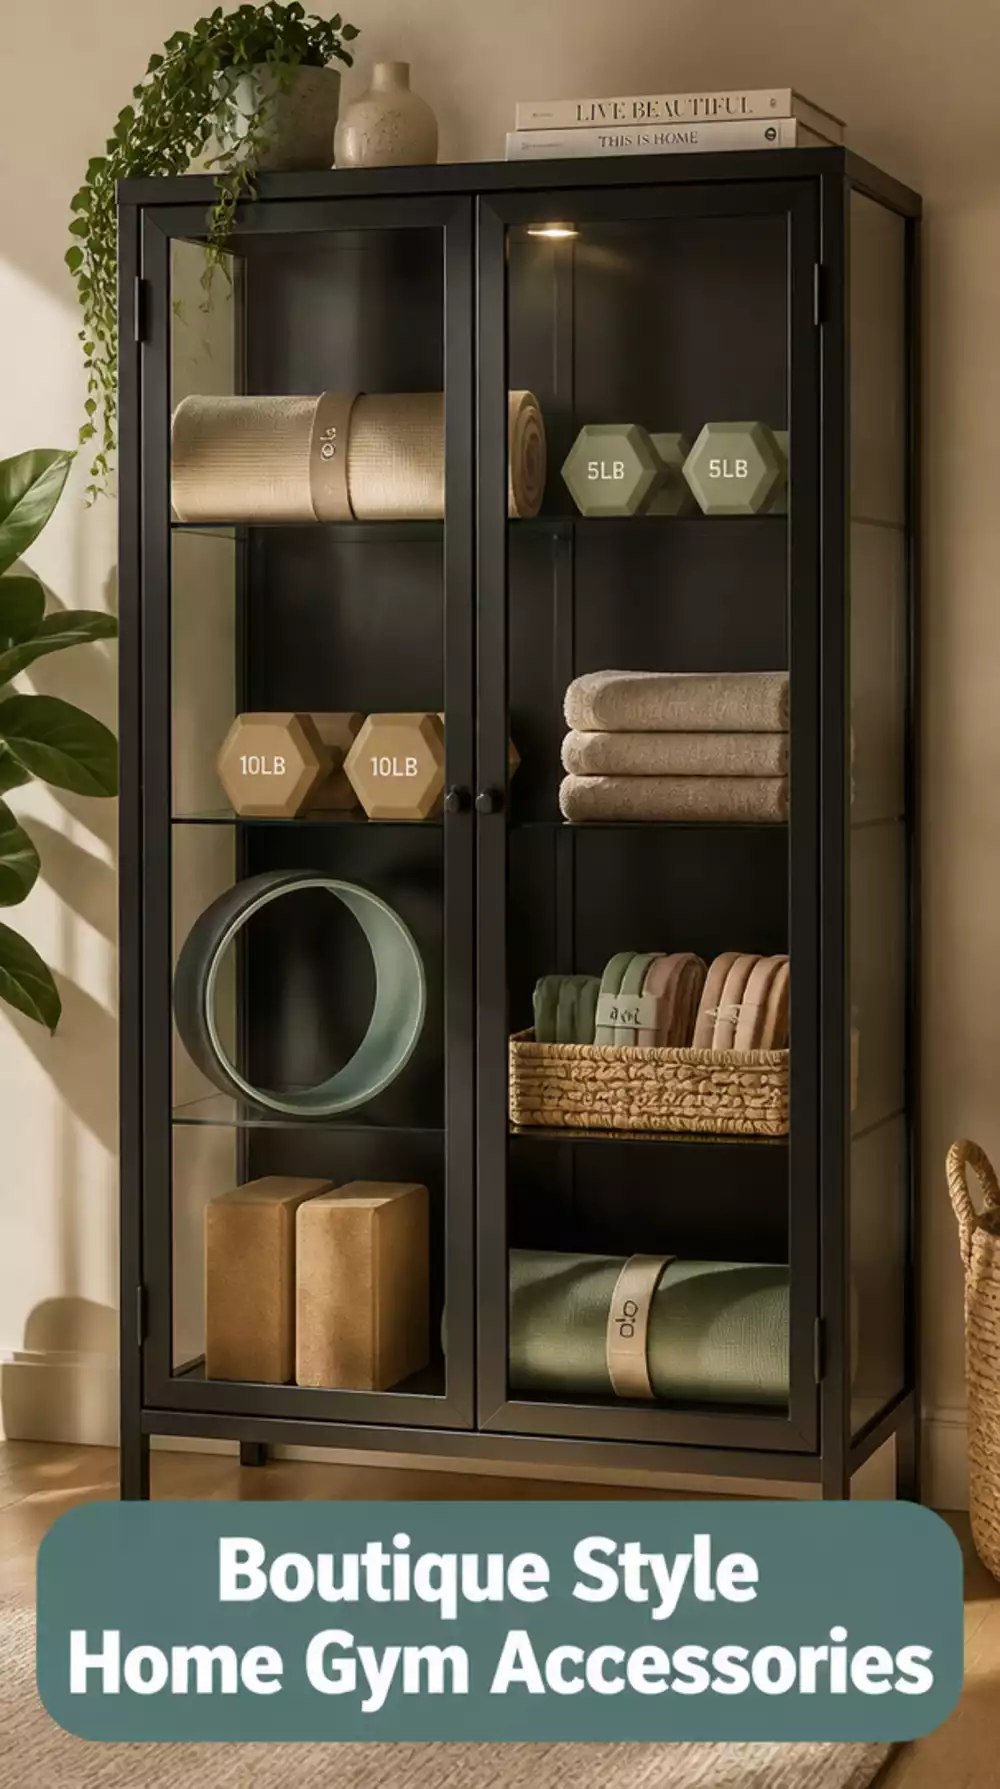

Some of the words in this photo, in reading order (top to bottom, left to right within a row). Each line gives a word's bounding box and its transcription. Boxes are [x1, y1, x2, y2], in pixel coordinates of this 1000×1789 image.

[576, 103, 626, 121] LIVE
[633, 97, 753, 119] BEAUTIFUL
[598, 134, 632, 148] THIS
[637, 132, 650, 146] IS
[654, 130, 698, 146] HOME
[587, 461, 625, 480] 5LB
[709, 459, 748, 479] 5LB
[239, 755, 286, 776] 10LB
[370, 757, 418, 777] 10LB
